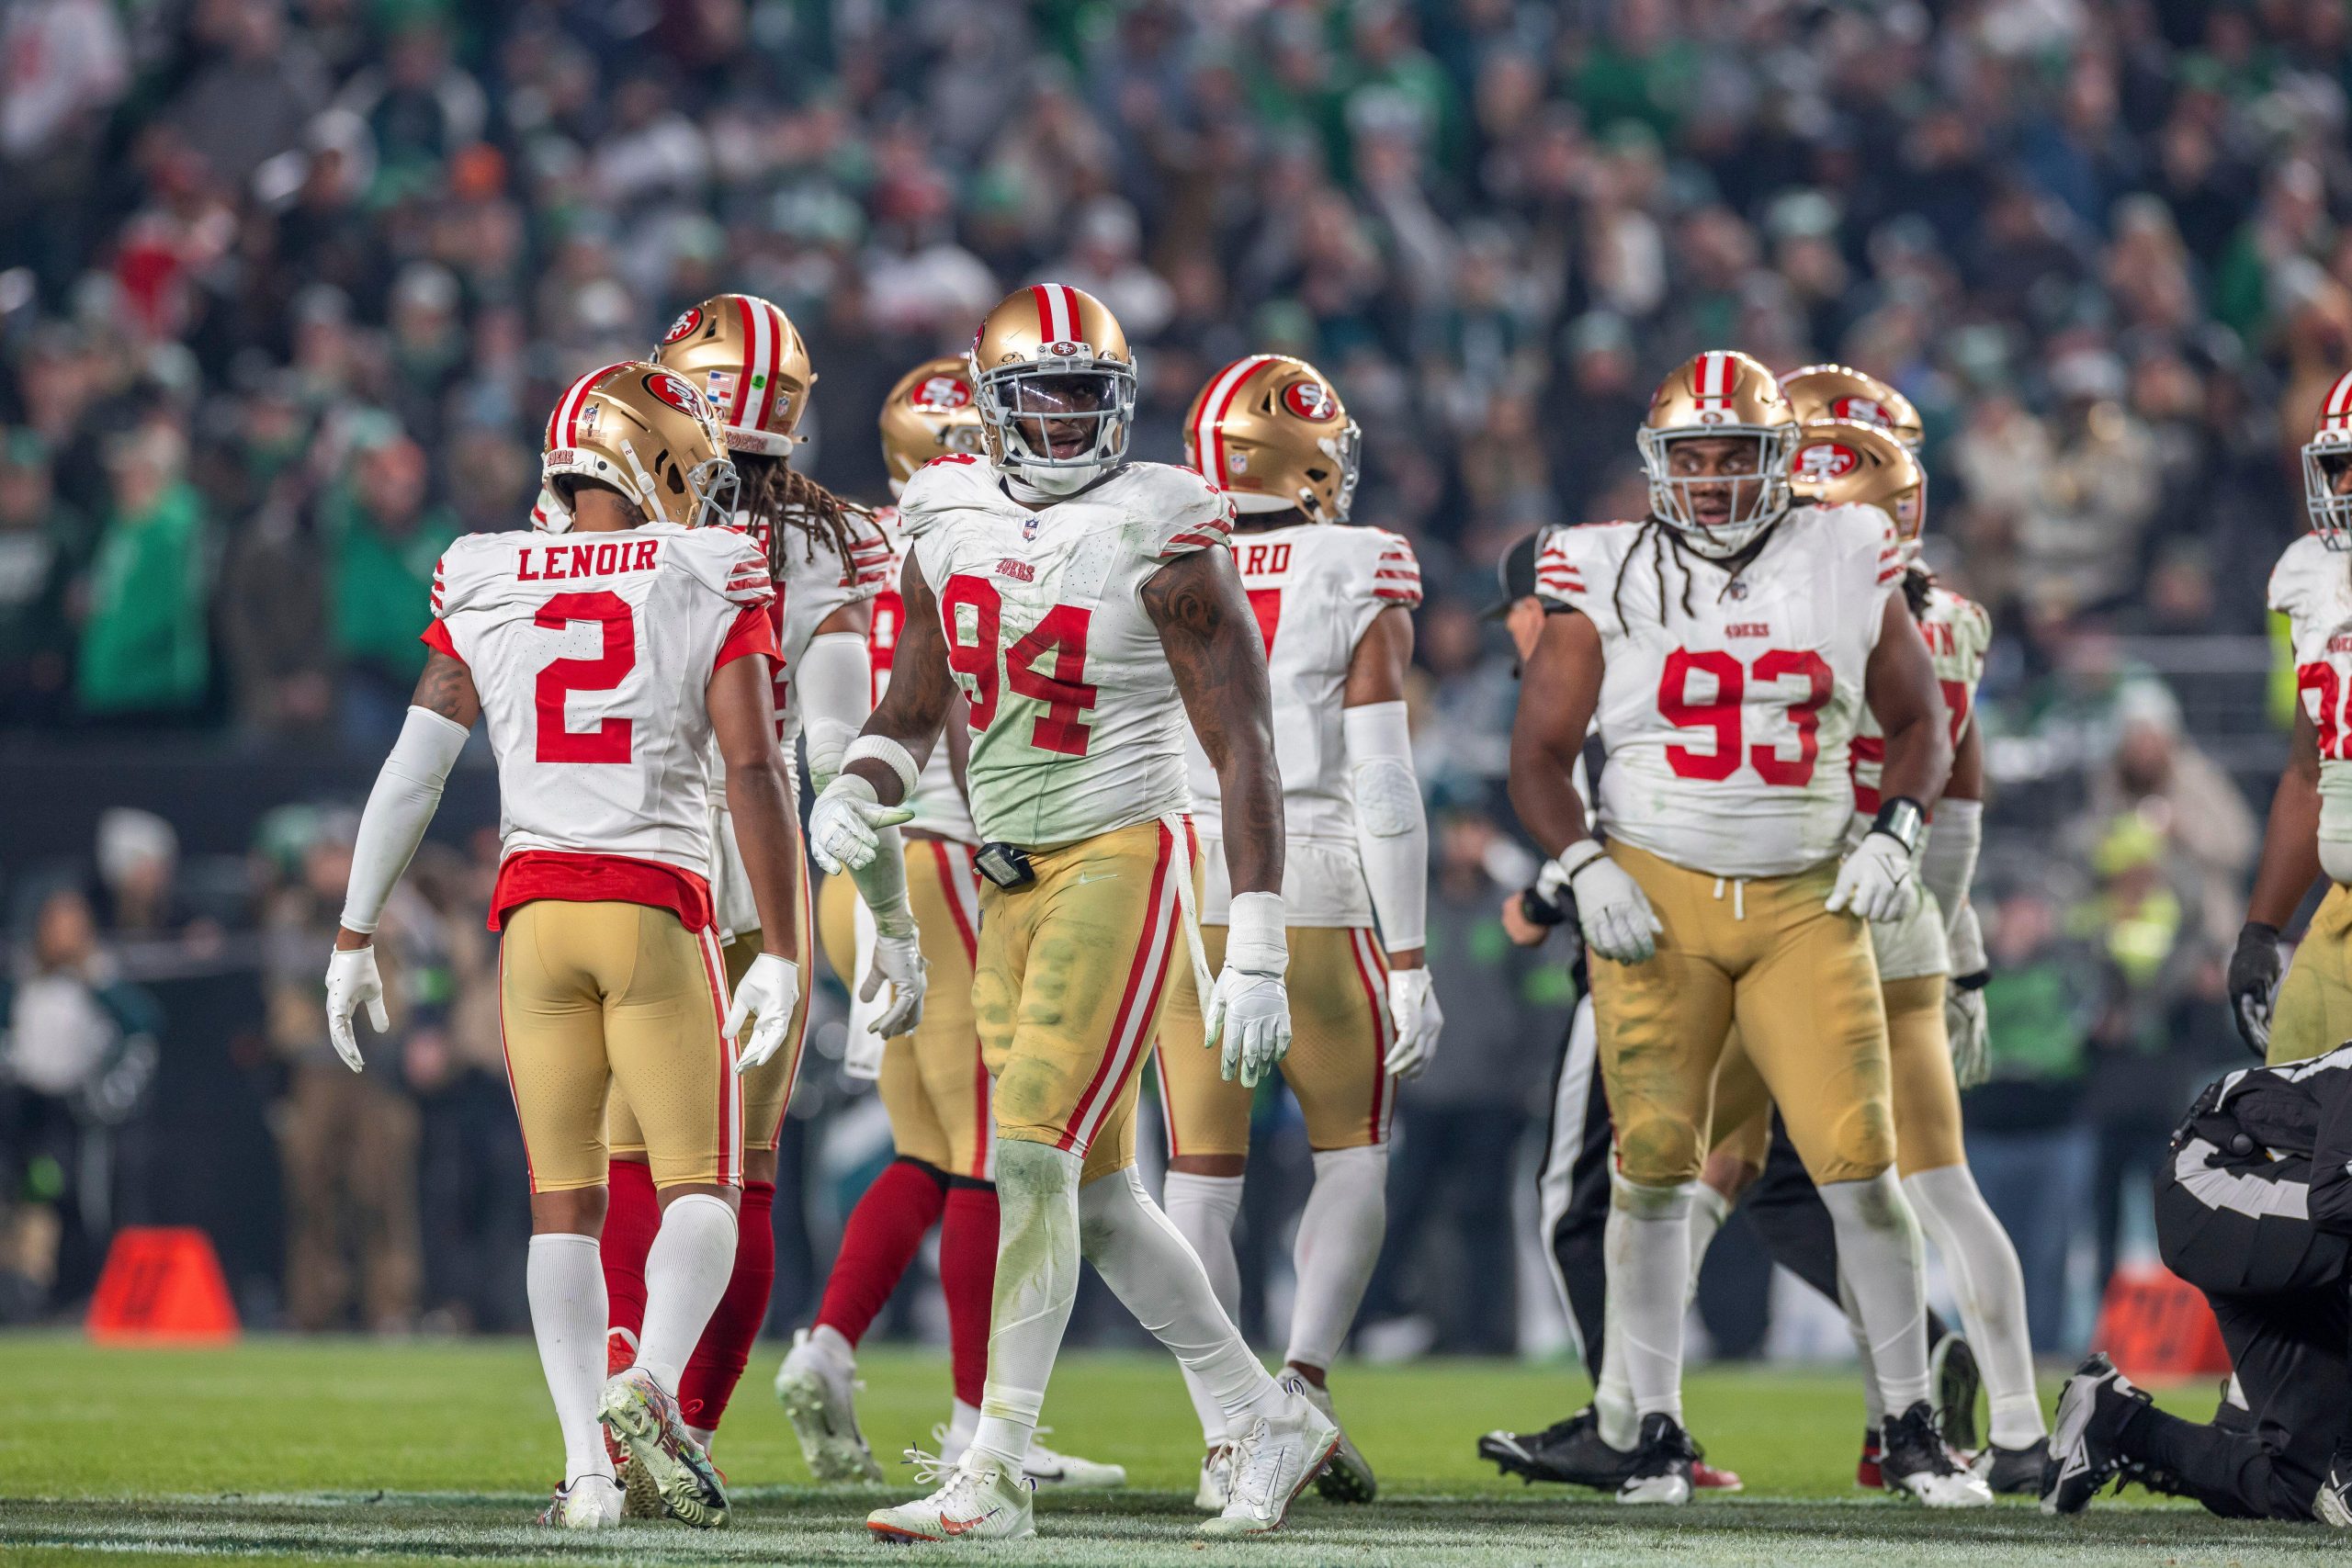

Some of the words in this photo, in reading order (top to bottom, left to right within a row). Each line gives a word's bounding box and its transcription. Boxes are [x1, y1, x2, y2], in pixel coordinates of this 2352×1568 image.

[517, 539, 659, 581] LENOIR
[534, 590, 636, 764] 2
[942, 574, 1099, 757] 94
[1657, 646, 1834, 787] 93
